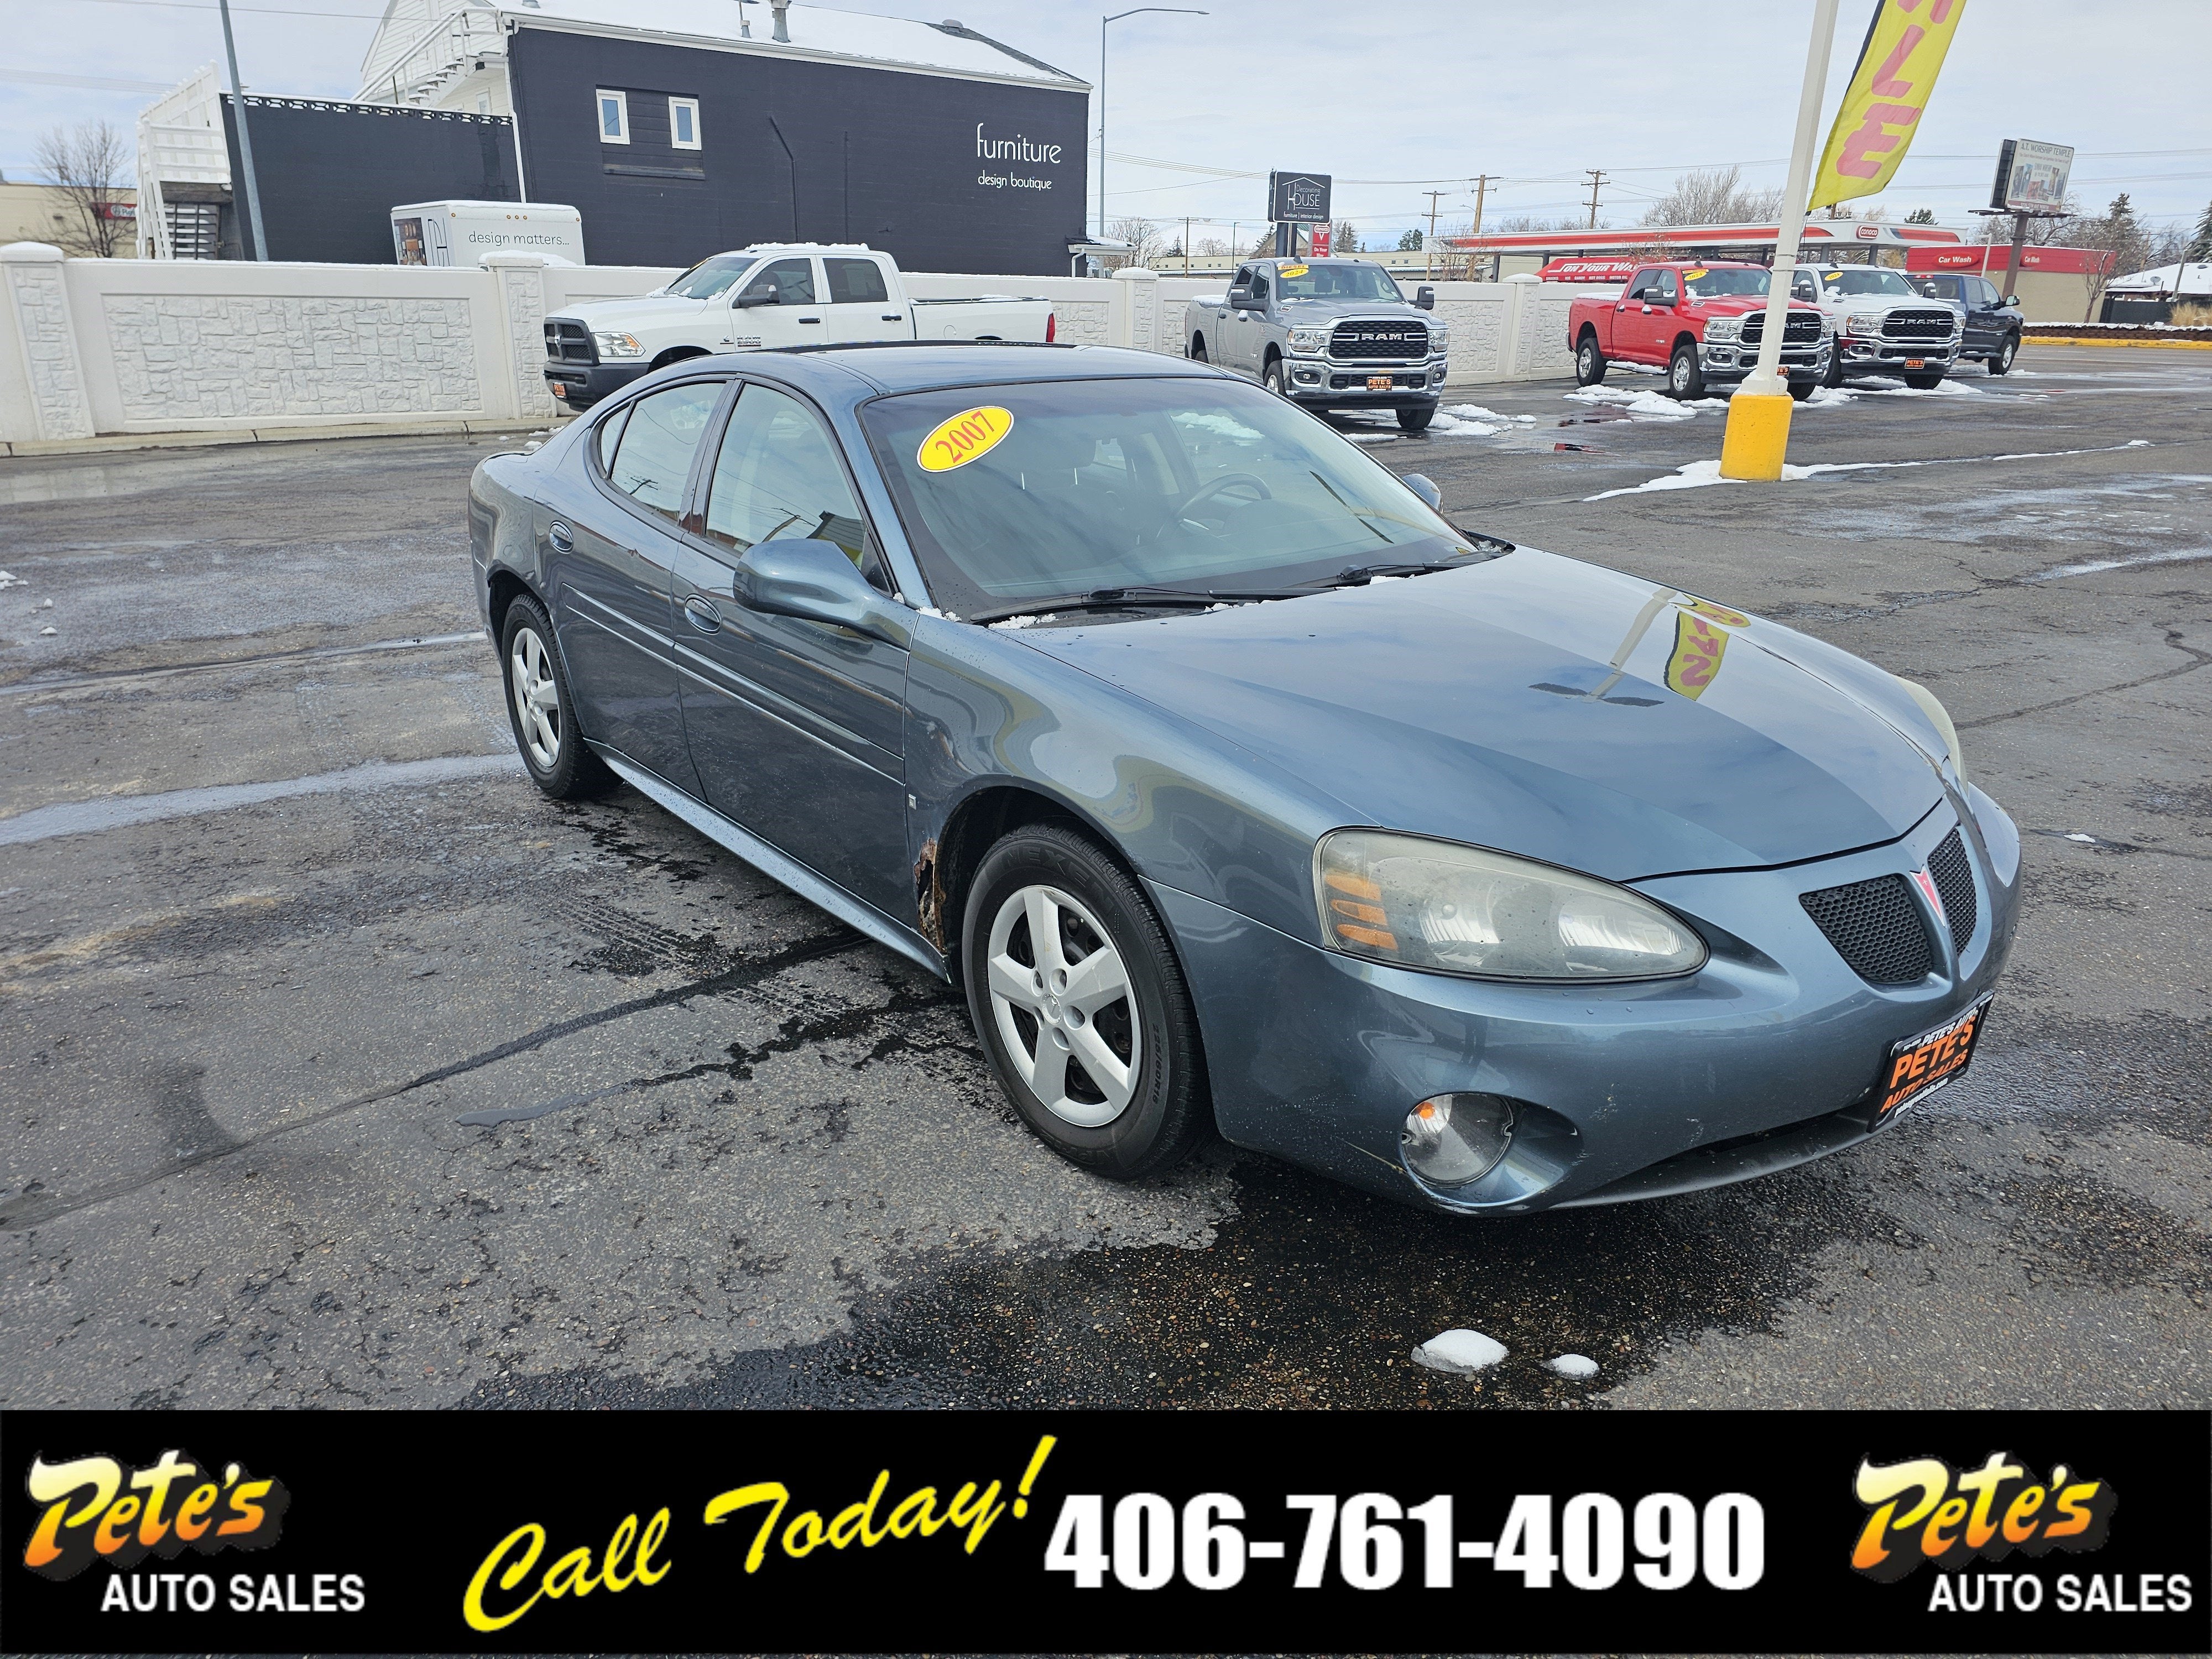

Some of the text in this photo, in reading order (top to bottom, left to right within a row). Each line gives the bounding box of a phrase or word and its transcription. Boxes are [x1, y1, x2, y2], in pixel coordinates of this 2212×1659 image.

[1836, 0, 1954, 179] LE
[977, 122, 1062, 164] furniture
[2021, 143, 2071, 158] A.T. WORSHIP TEMPLE
[978, 169, 1052, 191] design boutique
[1296, 184, 1321, 194] Decorating
[468, 230, 570, 247] design matters...
[935, 410, 994, 463] 2007
[1922, 1022, 1956, 1046] PETE'S
[1890, 1015, 1976, 1089] PETE'S
[1880, 1048, 1968, 1113] AUTO SALES
